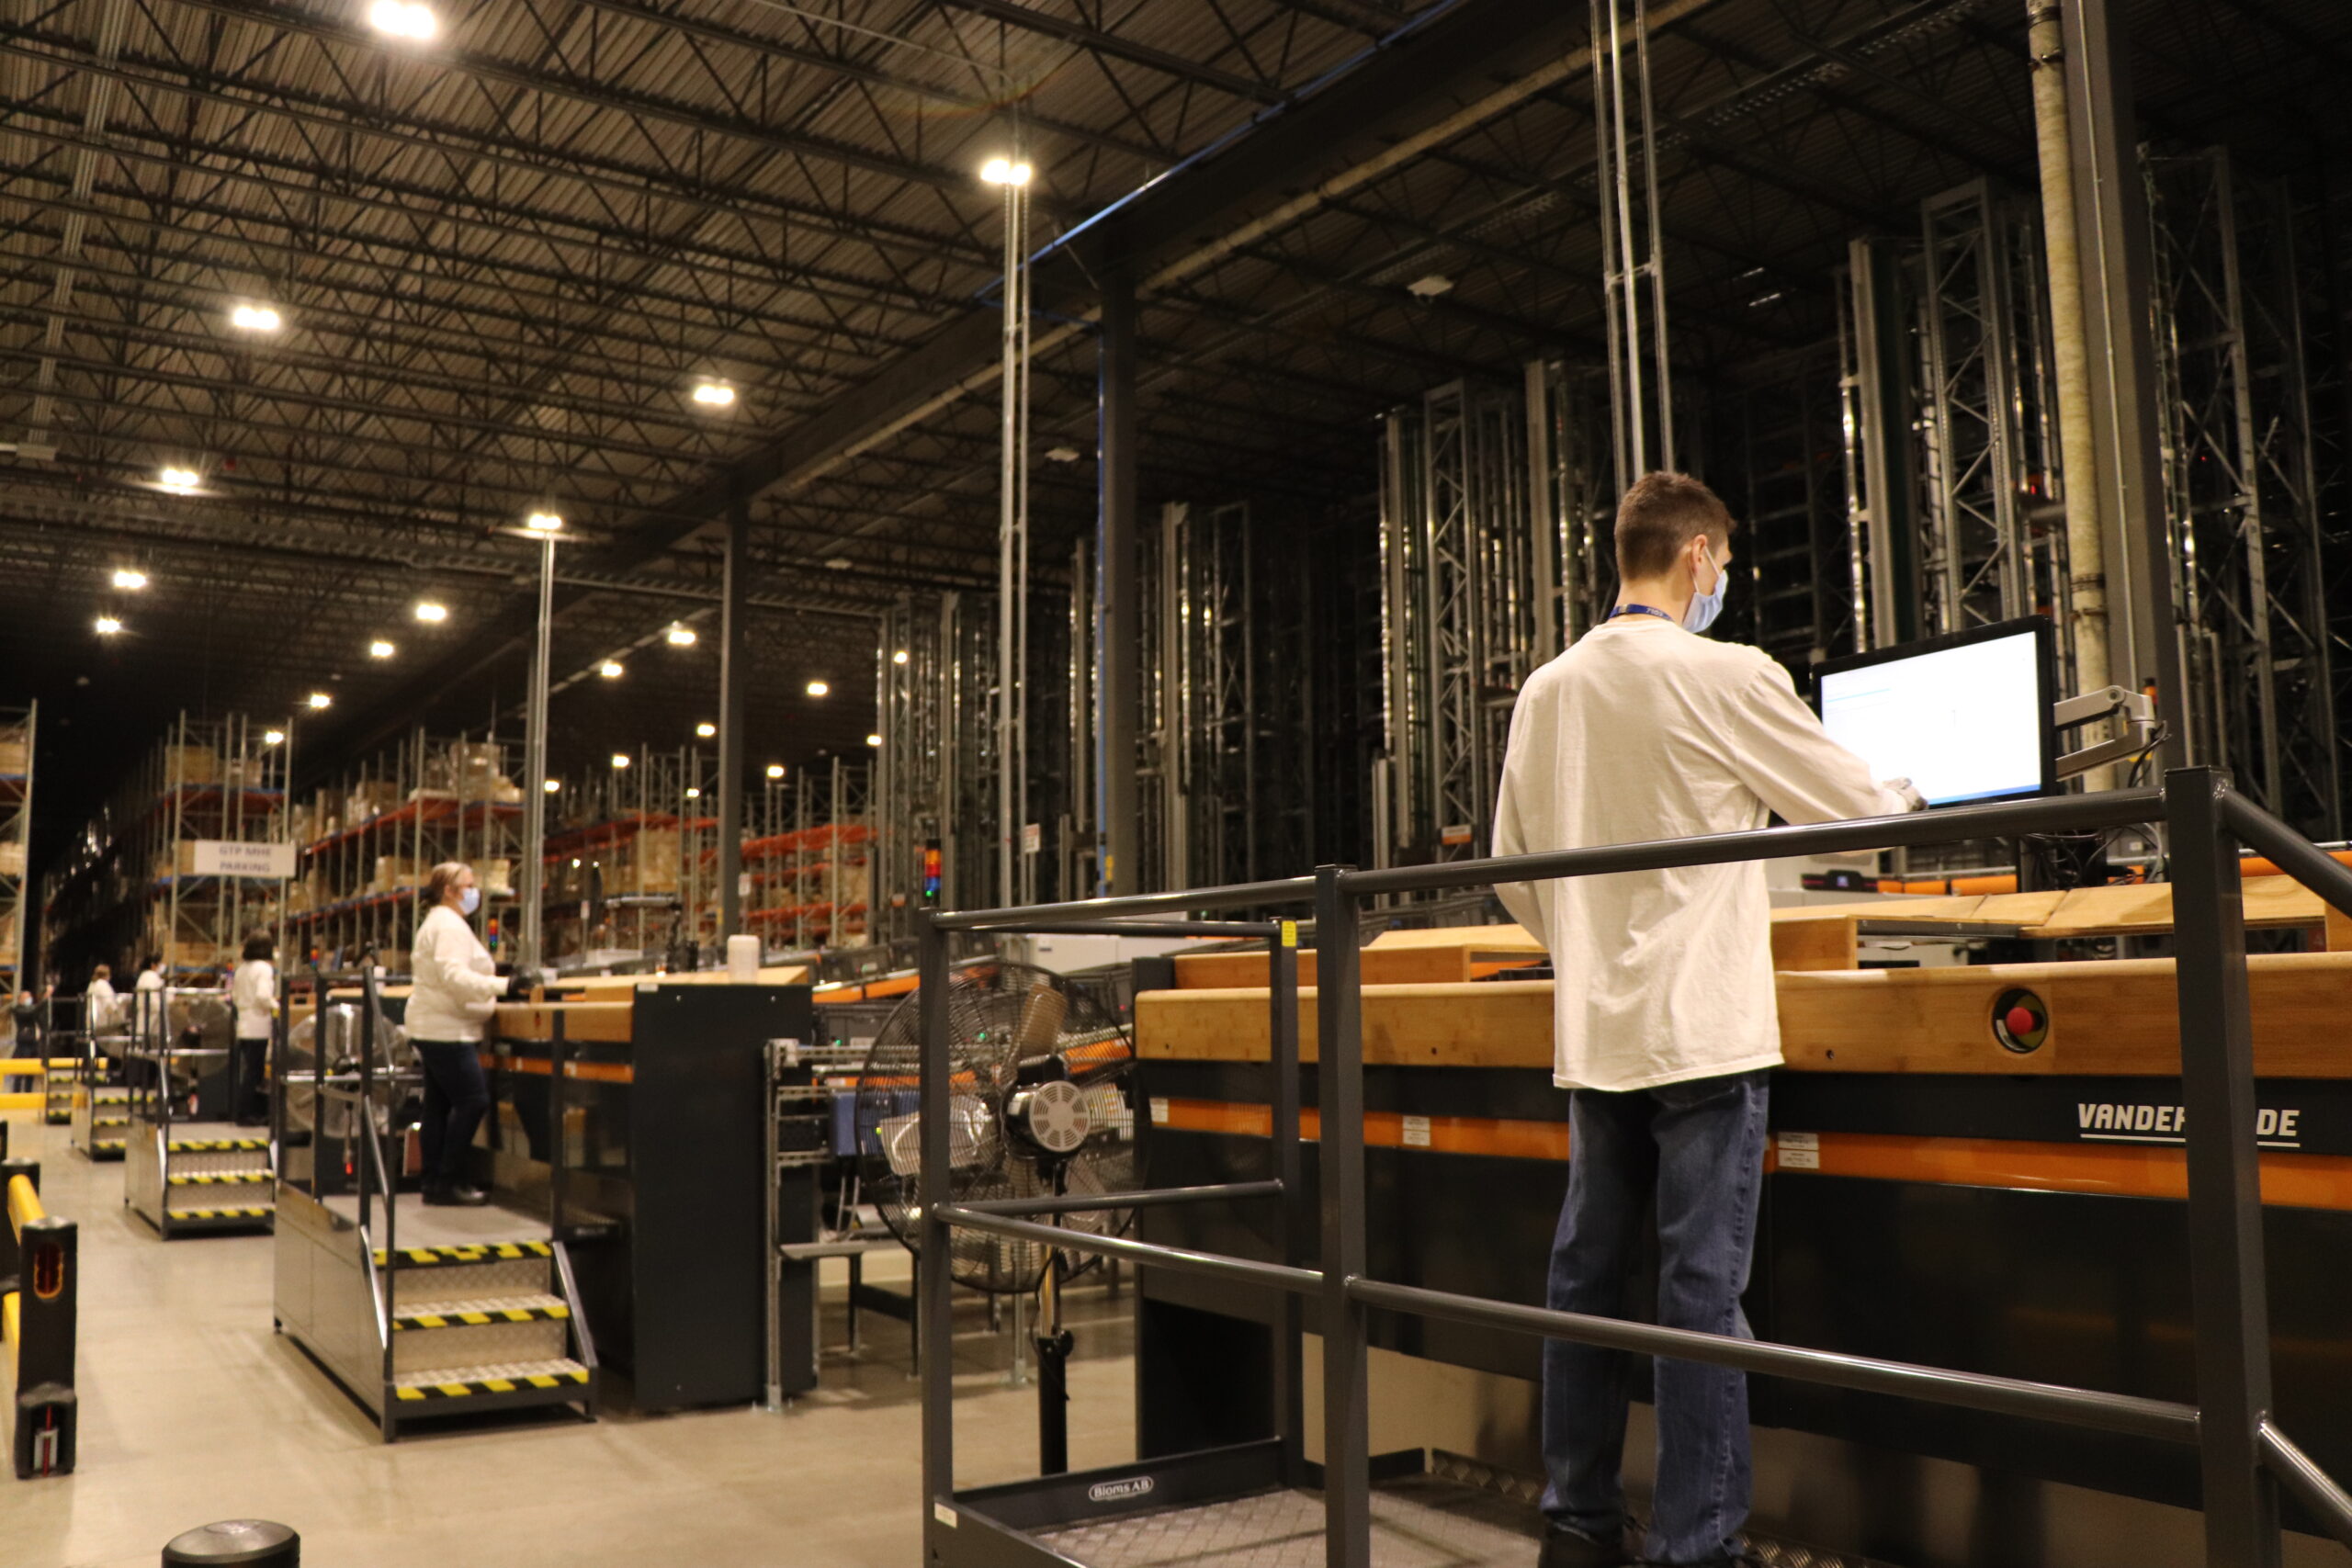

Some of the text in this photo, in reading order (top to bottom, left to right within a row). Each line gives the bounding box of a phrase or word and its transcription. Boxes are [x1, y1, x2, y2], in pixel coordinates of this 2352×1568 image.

[220, 862, 271, 873] PARKING
[2077, 1103, 2300, 1136] VANDERDE
[1132, 1481, 1148, 1492] AB
